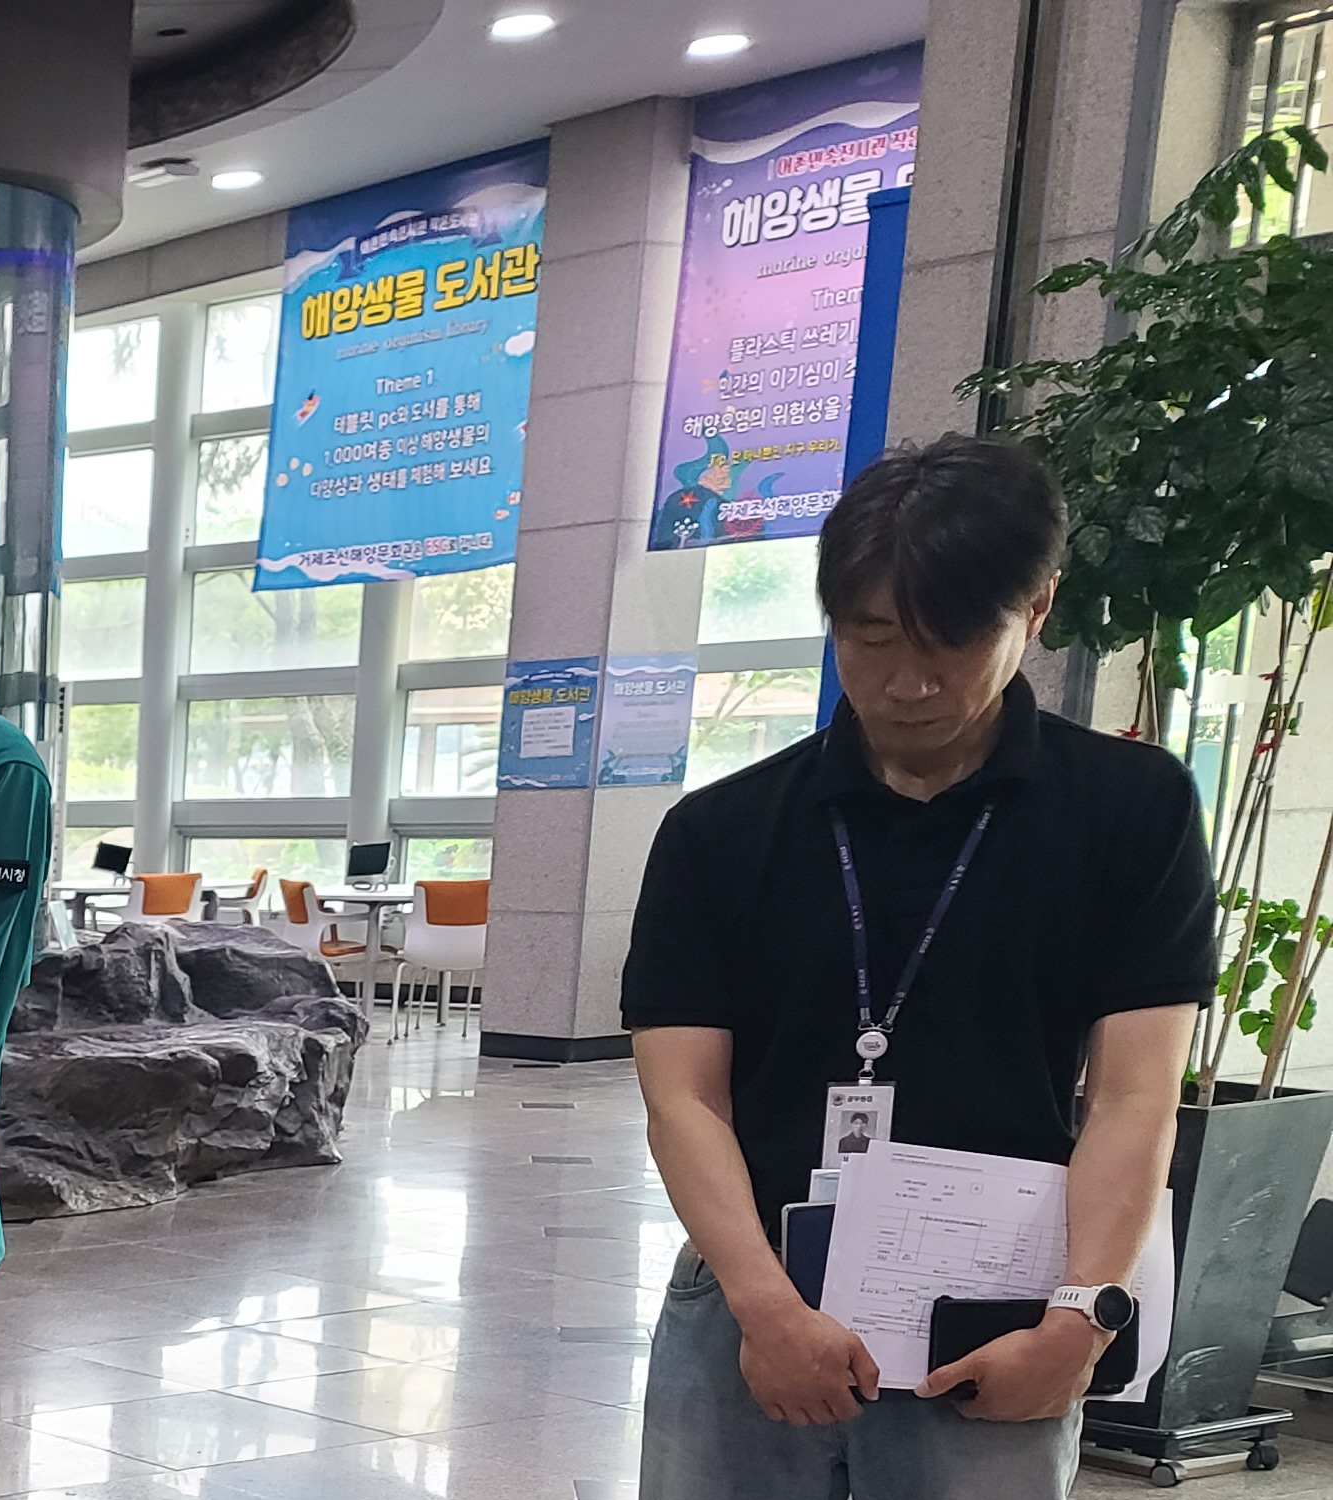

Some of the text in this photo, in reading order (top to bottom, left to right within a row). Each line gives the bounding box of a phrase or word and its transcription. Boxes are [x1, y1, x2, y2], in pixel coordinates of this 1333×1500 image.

[722, 169, 882, 248] 해양생물
[757, 244, 868, 279] marine orga
[301, 243, 541, 340] 해양생물 도서관
[730, 318, 858, 363] 플라스틱 쓰레기
[376, 373, 422, 395] Theme
[719, 370, 764, 400] 인간의
[770, 357, 840, 391] 이기심이
[334, 391, 482, 434] 태블릿 pc와 도서를 통해
[683, 406, 768, 438] 해양오염의
[772, 396, 841, 426] 위험성을
[396, 435, 420, 456] 이상
[421, 423, 490, 451] 해양생물의
[310, 474, 364, 500] 다양성과
[367, 467, 408, 493] 생태를
[410, 460, 446, 485] 체험해
[718, 491, 842, 520] 거제조선해양문화
[299, 540, 422, 567] 거제조선해양문화관은
